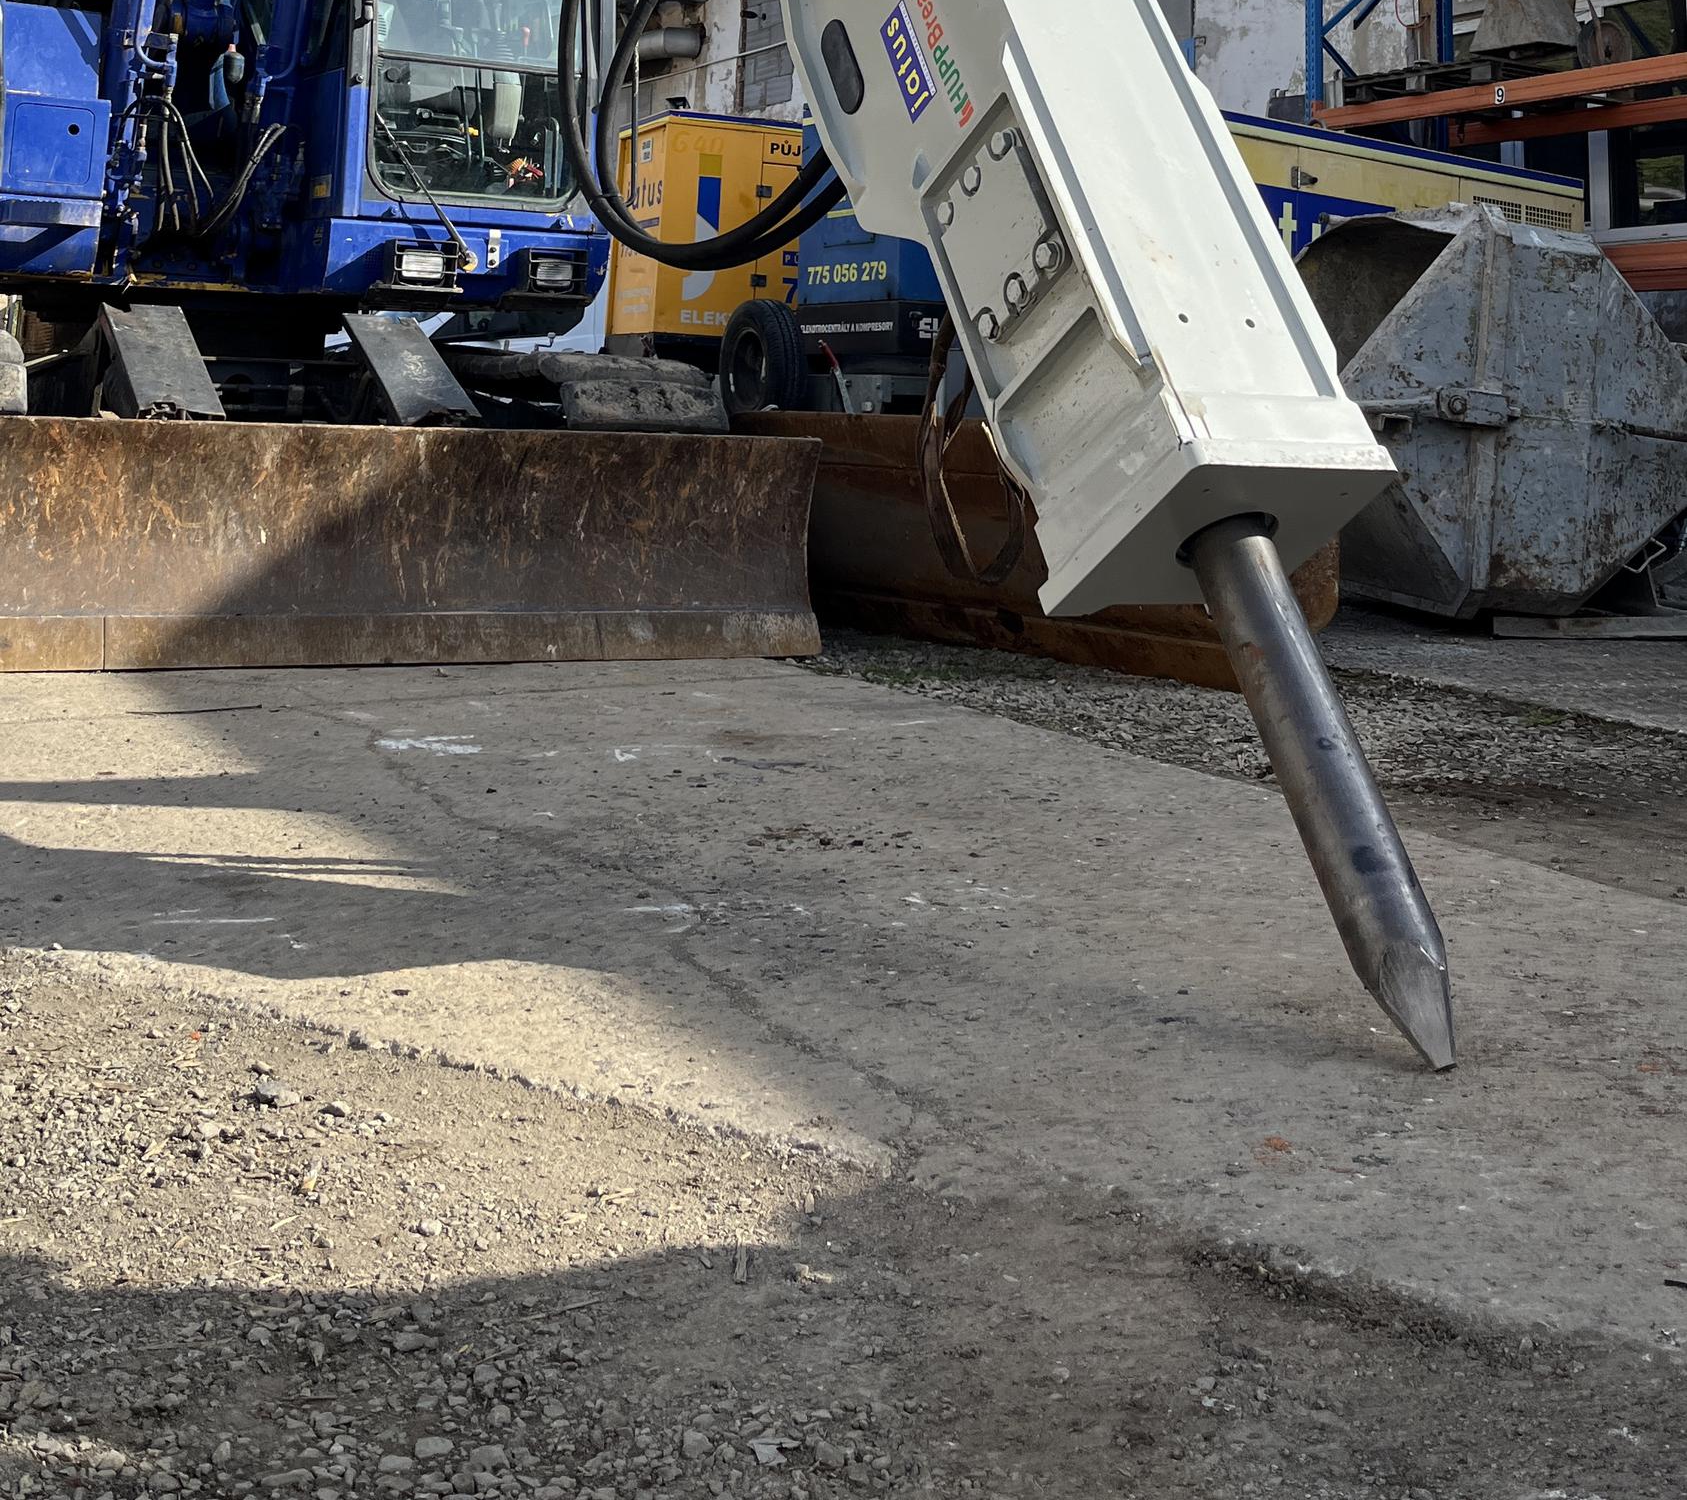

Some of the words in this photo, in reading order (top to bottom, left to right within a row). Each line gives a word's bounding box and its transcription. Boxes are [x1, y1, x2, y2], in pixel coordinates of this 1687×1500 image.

[886, 17, 930, 114] jatus
[1496, 87, 1505, 103] 9
[807, 265, 830, 285] 775
[833, 262, 858, 284] 056
[861, 260, 887, 281] 279
